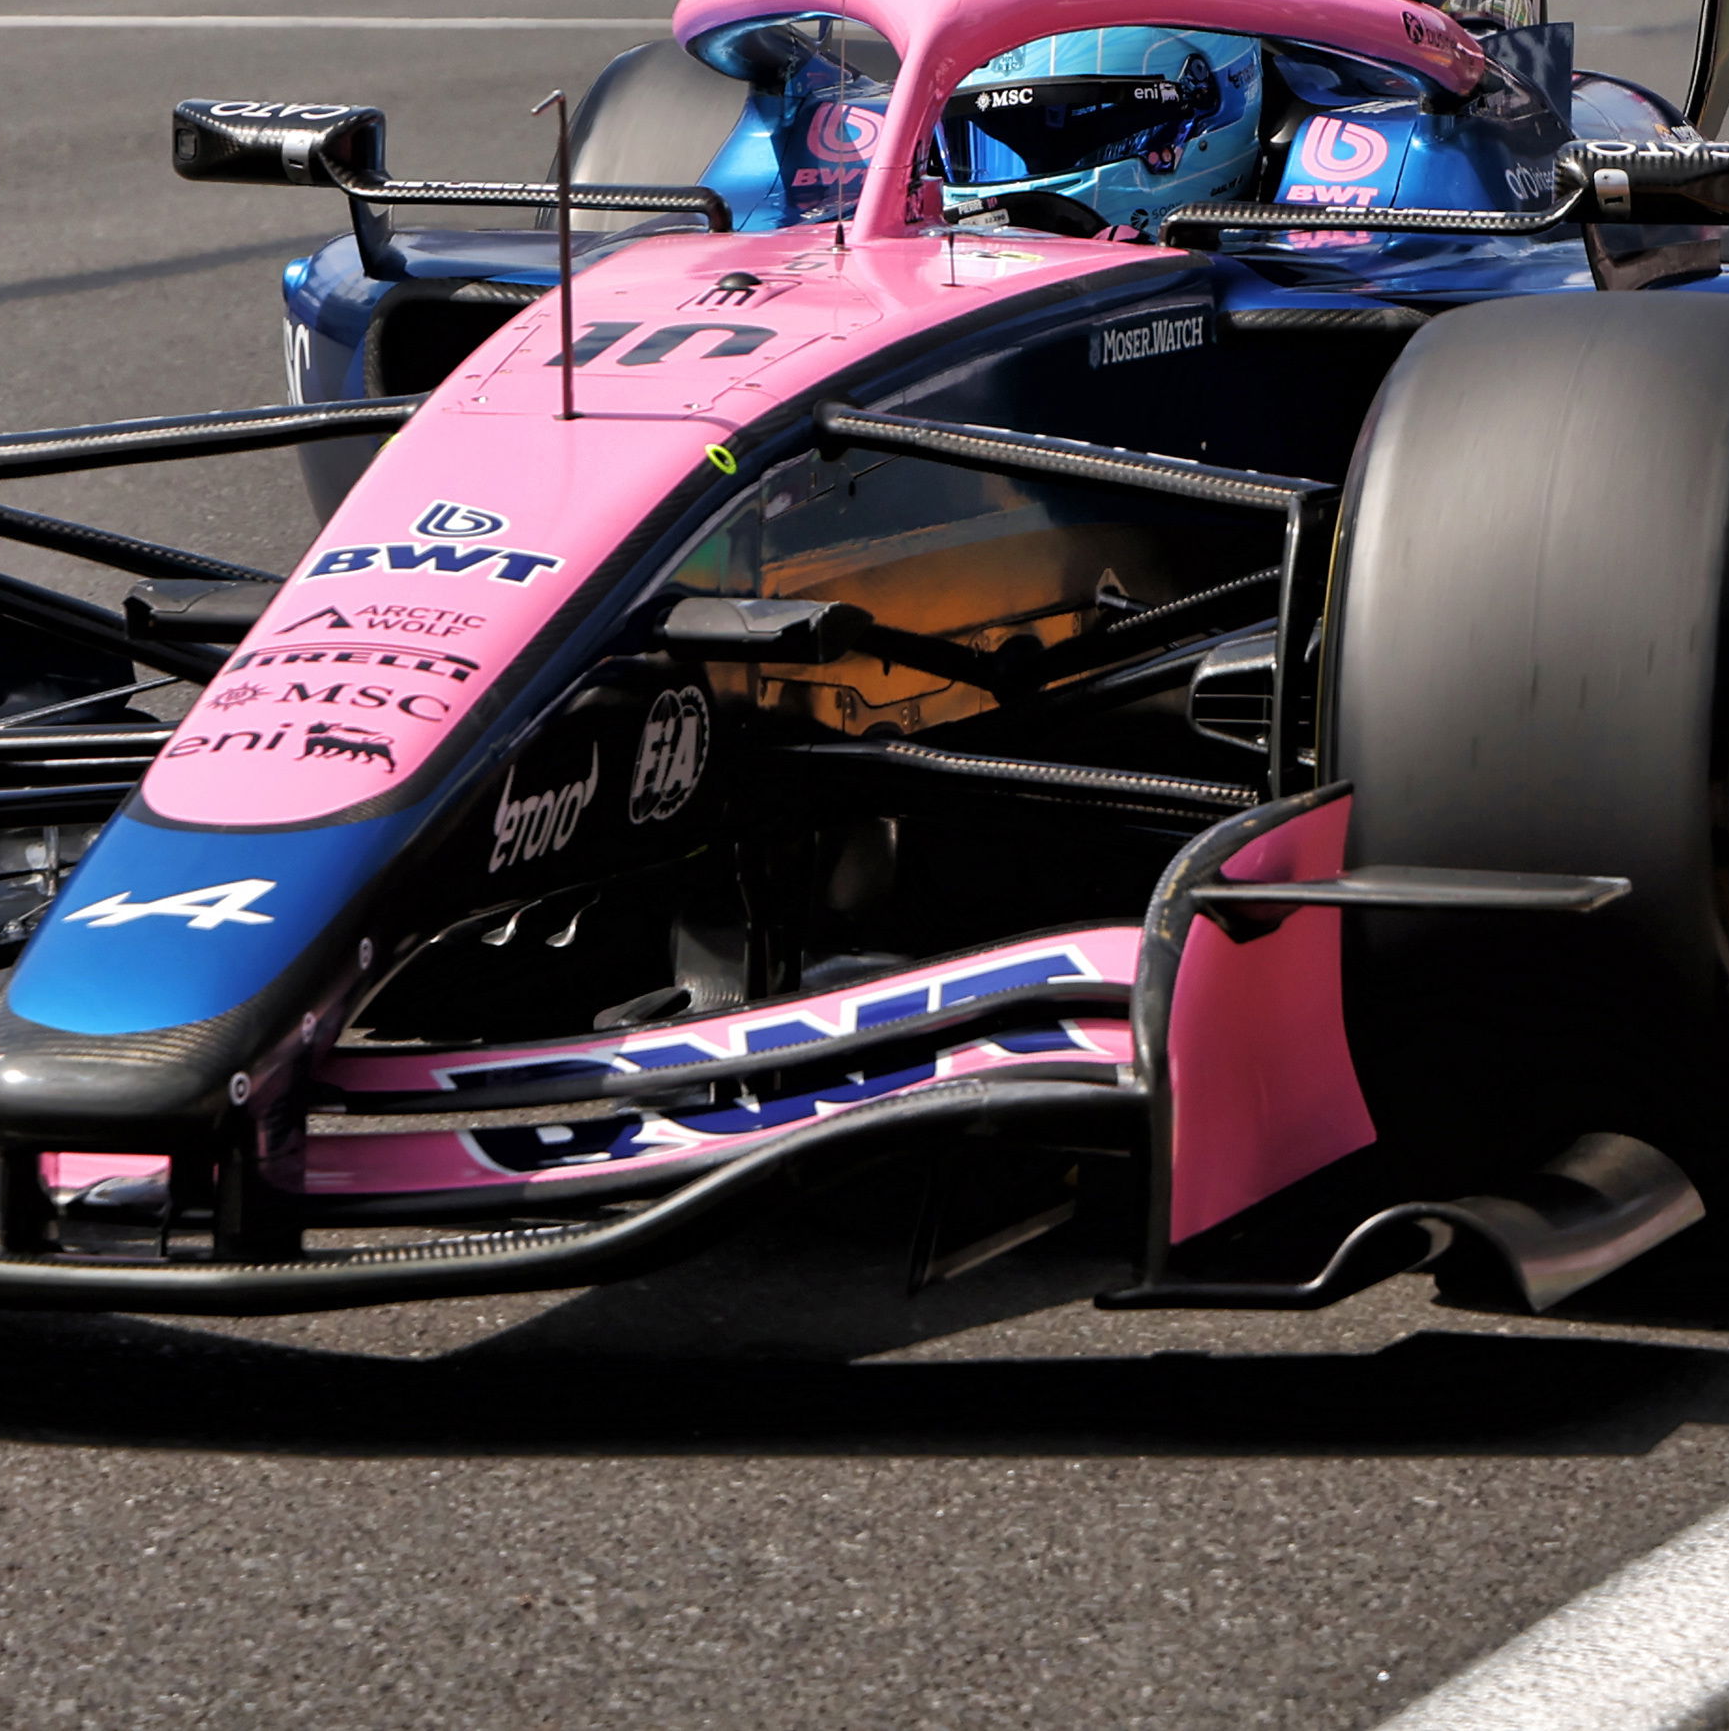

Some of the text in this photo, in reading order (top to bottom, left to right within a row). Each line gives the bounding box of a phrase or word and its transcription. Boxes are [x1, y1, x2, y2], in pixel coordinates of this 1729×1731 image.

[991, 87, 1033, 108] MSC
[1134, 84, 1159, 100] eni
[1286, 184, 1379, 207] BWT
[299, 542, 565, 587] BWT
[353, 604, 487, 629] ARCTIC
[366, 617, 466, 638] WOLF
[222, 642, 481, 684] PIRELLI
[274, 681, 451, 722] MSC
[164, 723, 294, 759] eni
